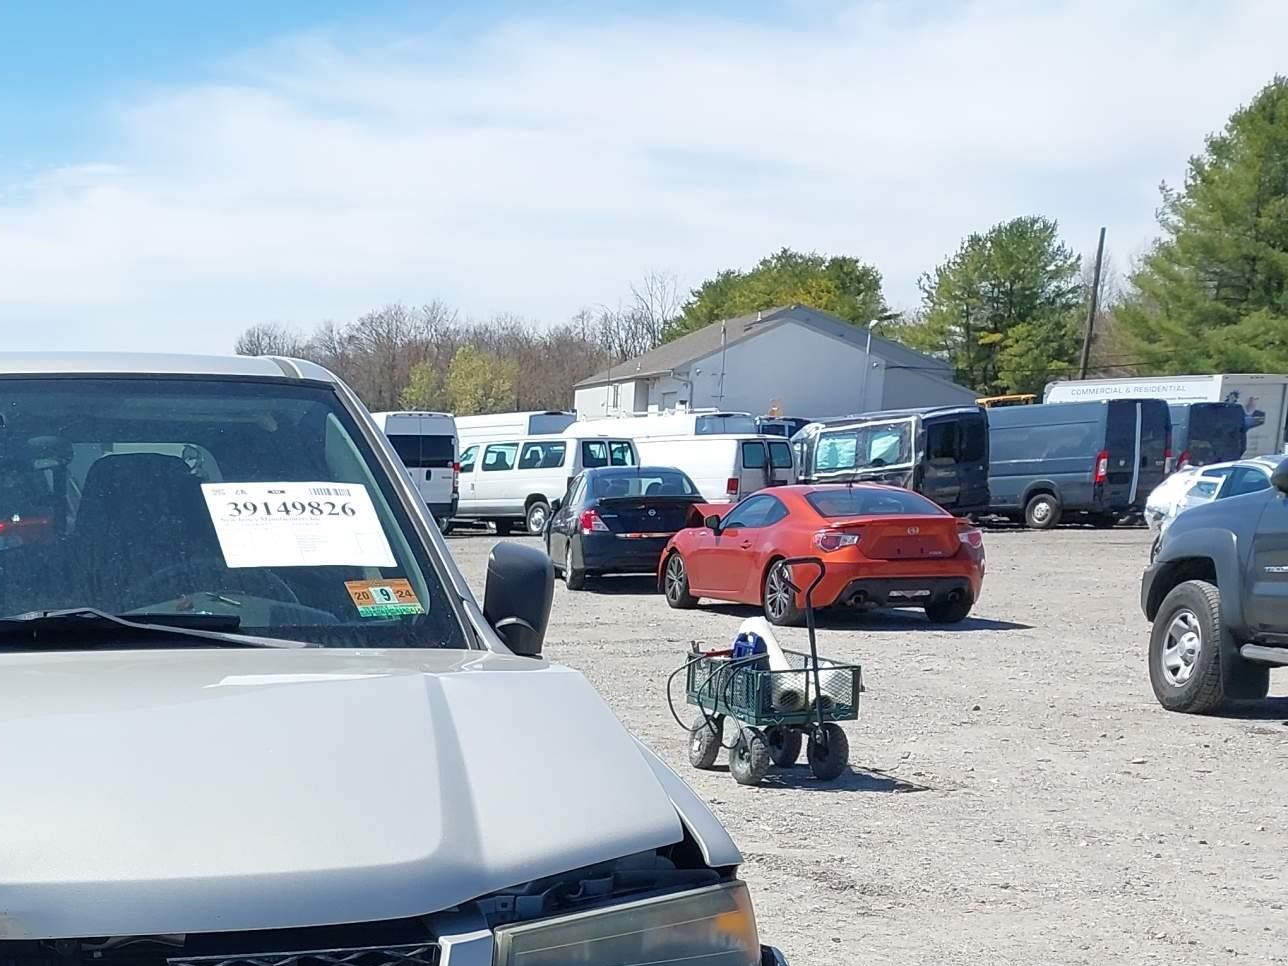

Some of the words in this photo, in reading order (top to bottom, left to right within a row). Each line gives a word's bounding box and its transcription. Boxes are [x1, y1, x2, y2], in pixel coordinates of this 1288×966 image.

[1071, 387, 1123, 396] COMMERCIAL
[1133, 385, 1186, 393] RESIDENTIAL
[226, 500, 357, 517] 39149826
[354, 591, 370, 601] 20
[379, 588, 391, 601] 9
[396, 590, 413, 598] 24
